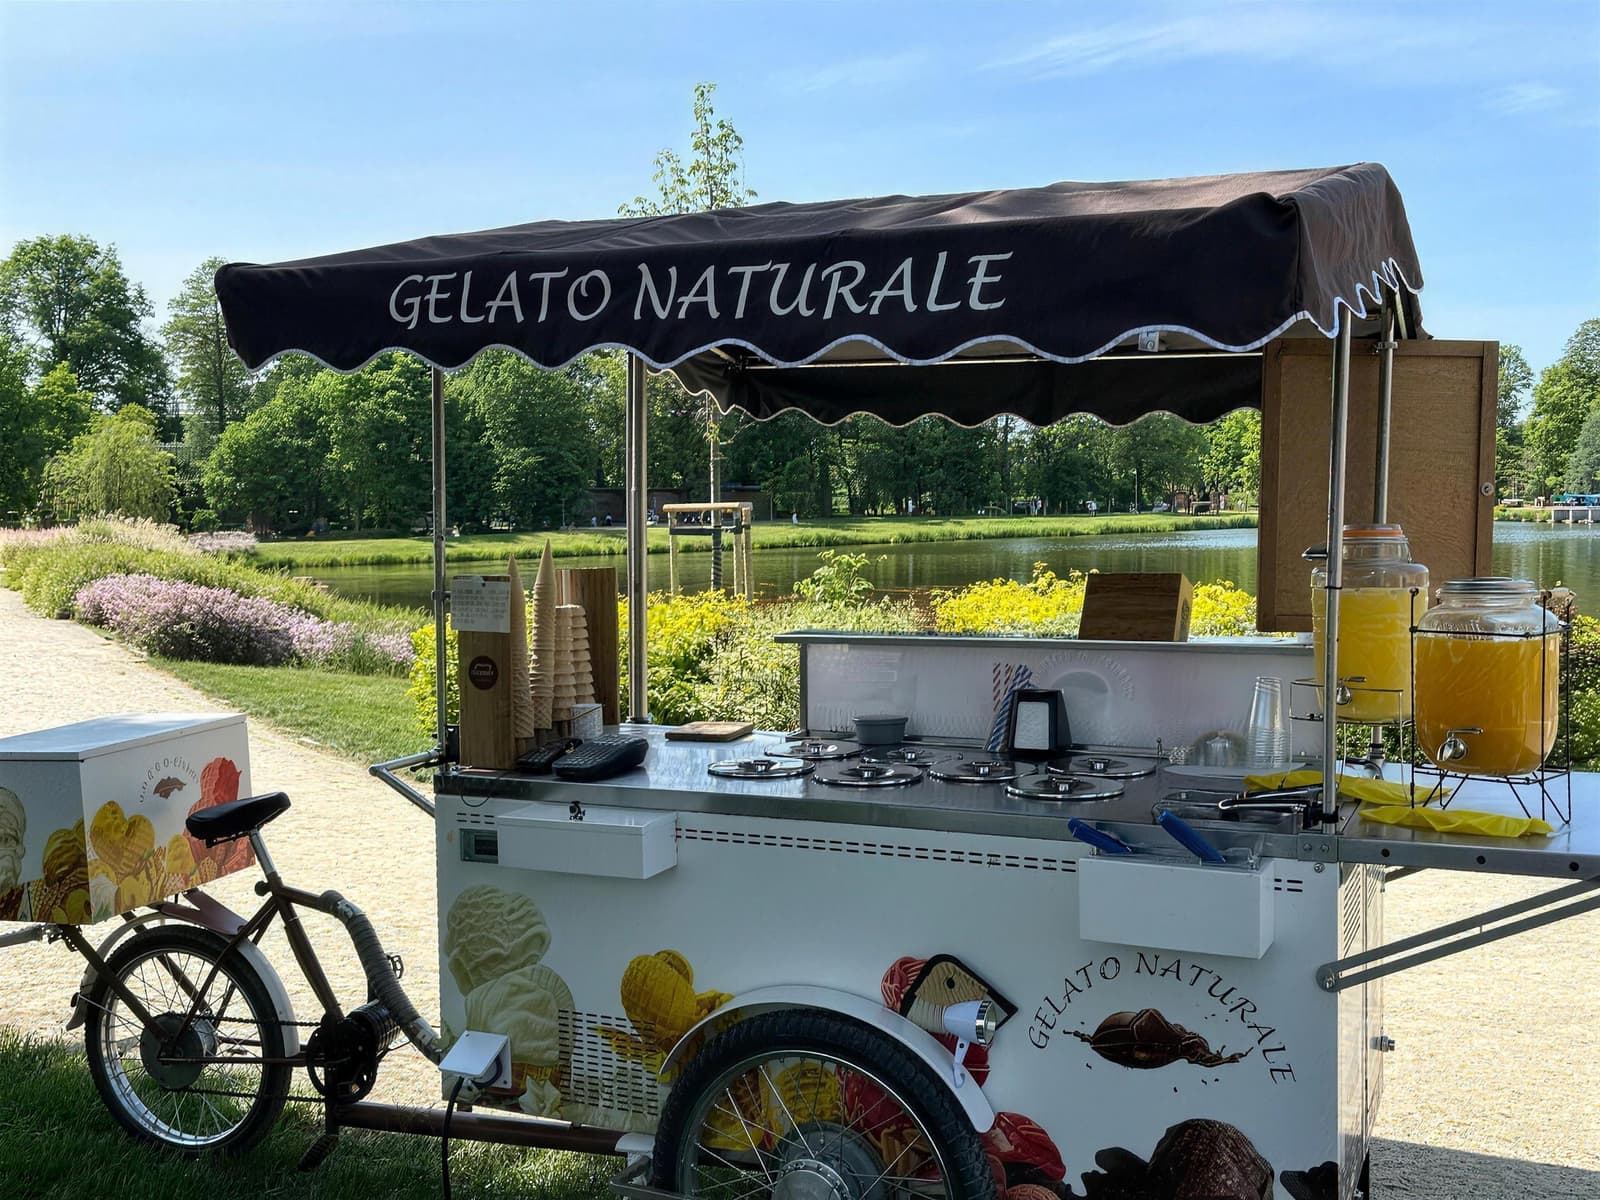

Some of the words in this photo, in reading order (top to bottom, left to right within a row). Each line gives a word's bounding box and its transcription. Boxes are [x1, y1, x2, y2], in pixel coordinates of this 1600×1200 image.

[389, 267, 613, 330] GELATO
[633, 251, 1014, 321] NATURALE
[1028, 956, 1121, 1050] GELATO
[1135, 951, 1297, 1085] NATURALE
